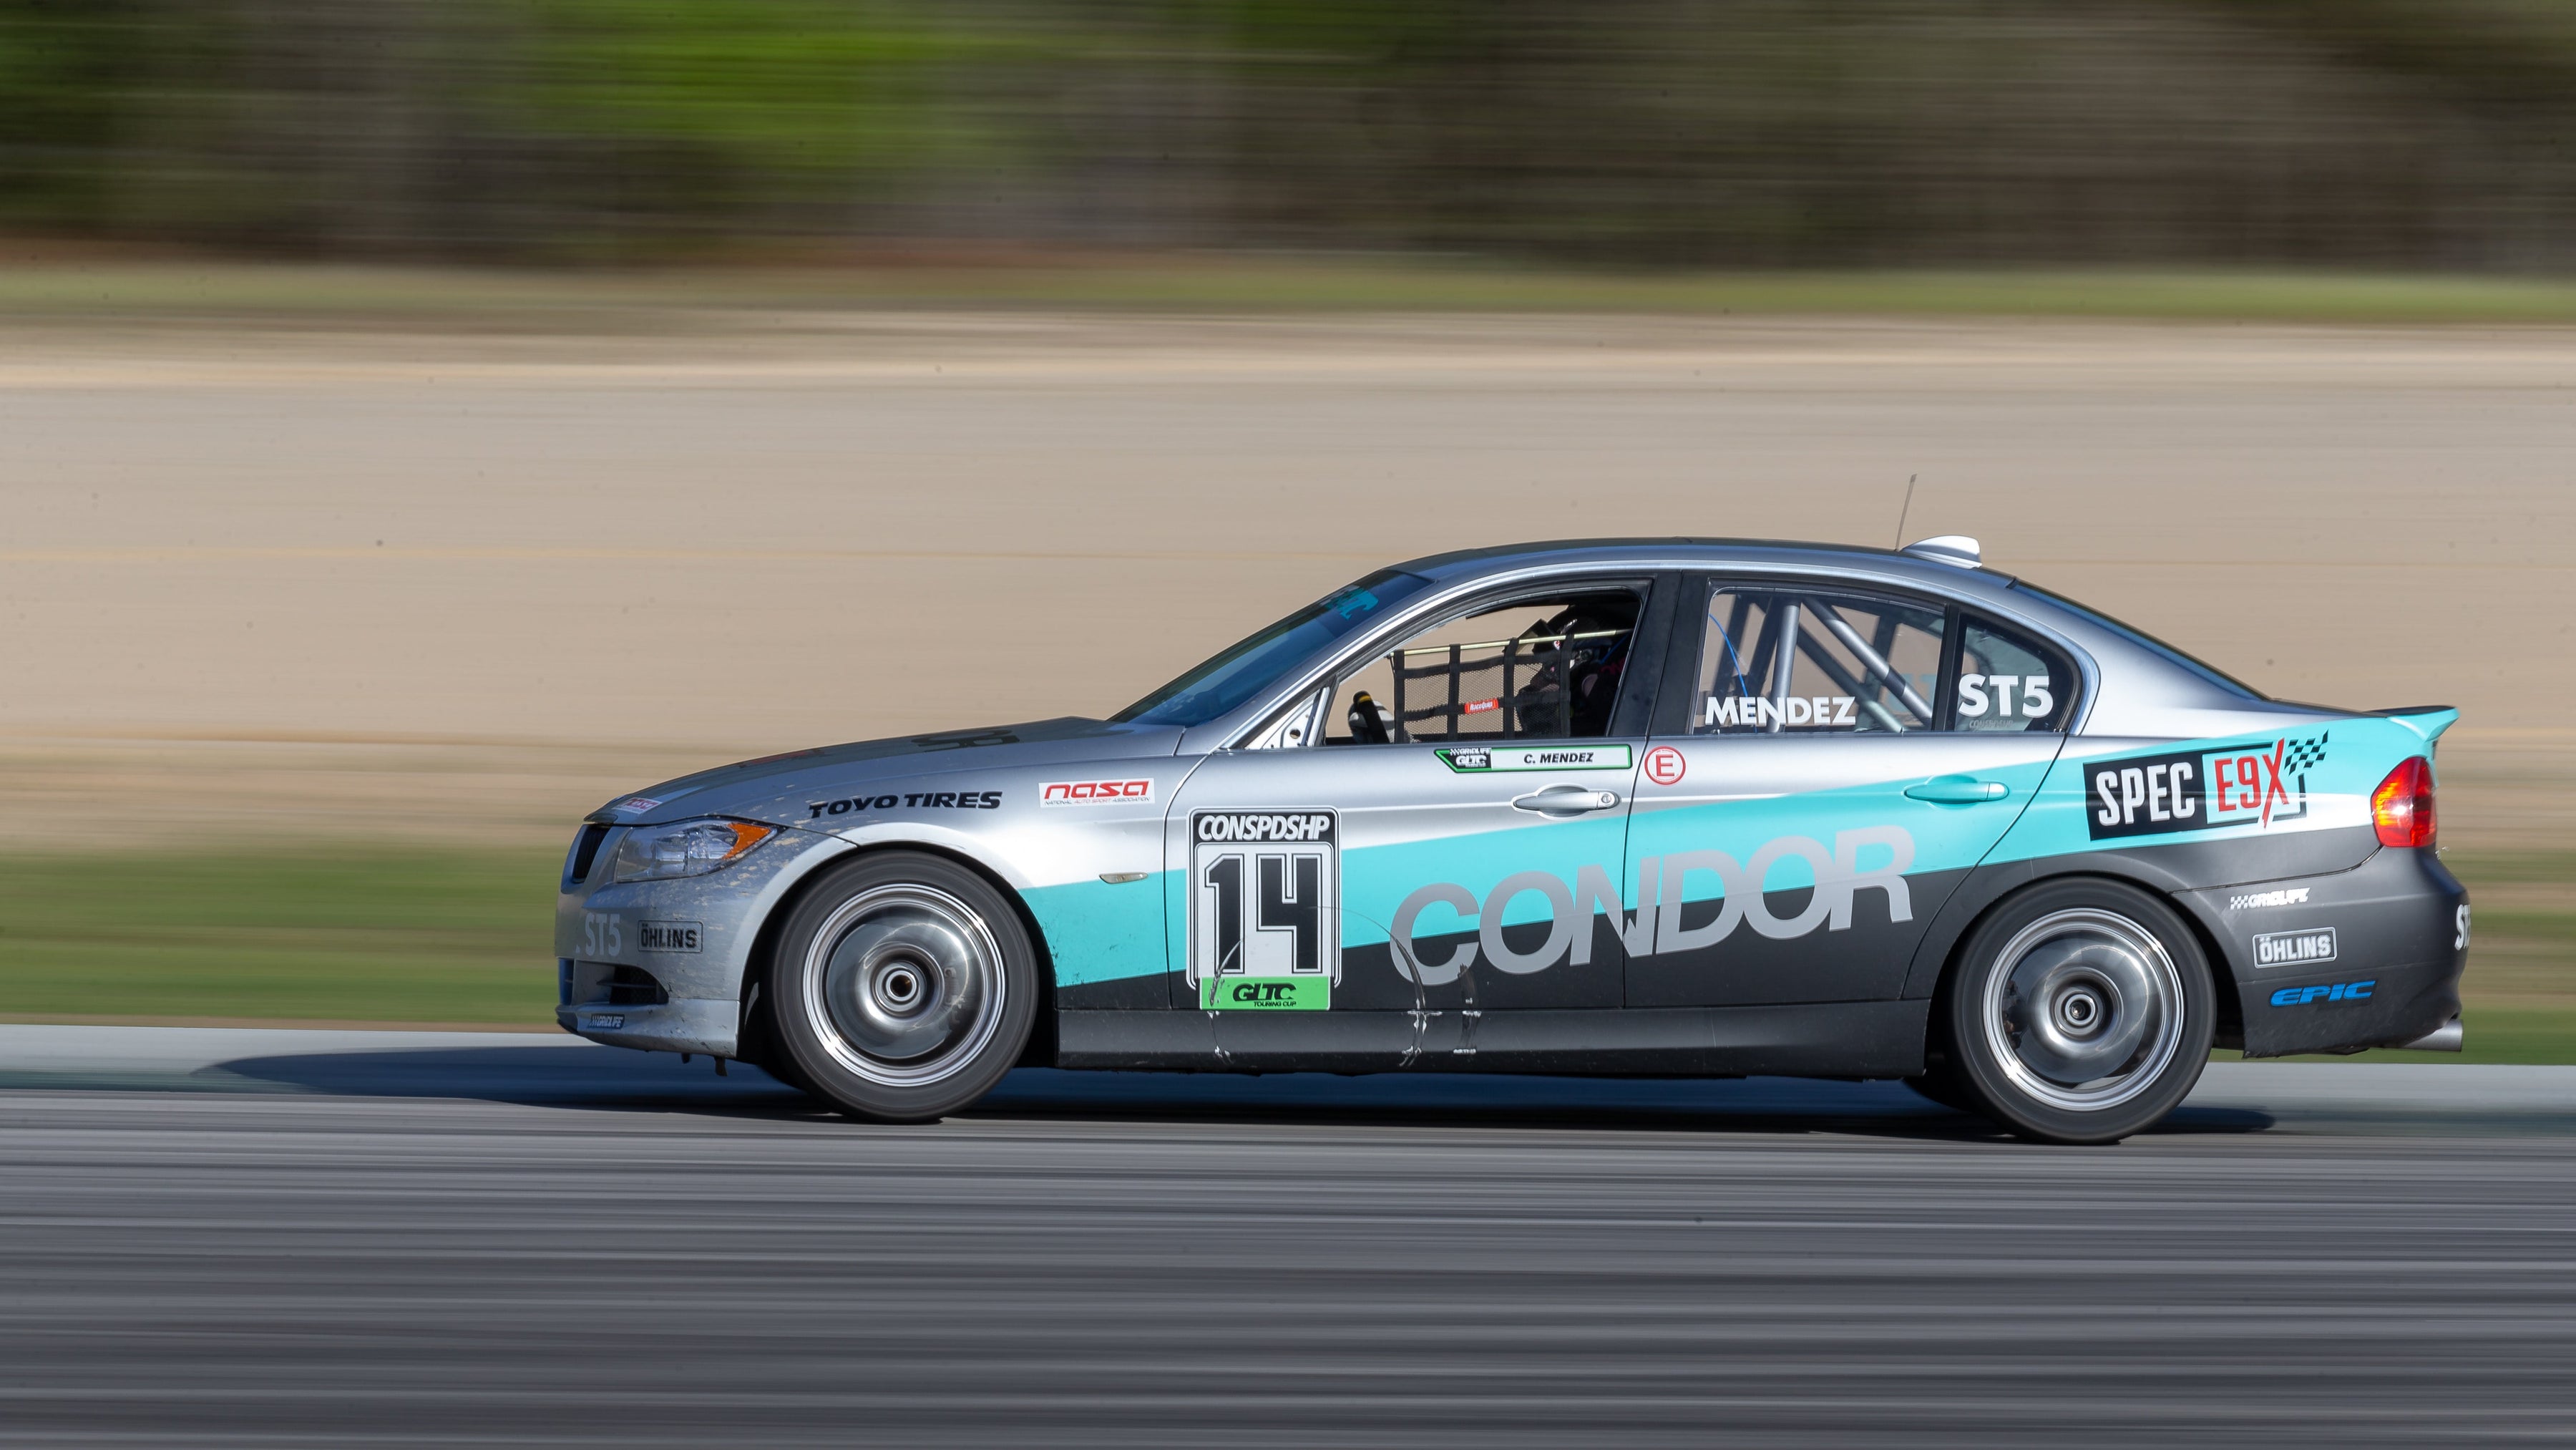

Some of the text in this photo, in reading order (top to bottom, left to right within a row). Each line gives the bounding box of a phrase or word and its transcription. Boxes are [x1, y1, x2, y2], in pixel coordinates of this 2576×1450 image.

[1958, 673, 2054, 718] ST5
[1704, 696, 1856, 726] MENDEZ
[1523, 752, 1594, 764] C. MENDEZ
[1656, 754, 1675, 777] E
[2095, 738, 2290, 829] SPEC E9X
[809, 791, 1002, 819] TOYO TIRES
[1198, 814, 1330, 841] CONSPDSHP
[1204, 853, 1322, 974] 14
[1389, 824, 1915, 986] CONDOR
[585, 912, 622, 956] ST5
[640, 923, 698, 948] ÖHLINS
[2259, 934, 2332, 963] ÖHLINS
[1232, 983, 1297, 1001] GLTC
[2270, 981, 2376, 1007] EPIC
